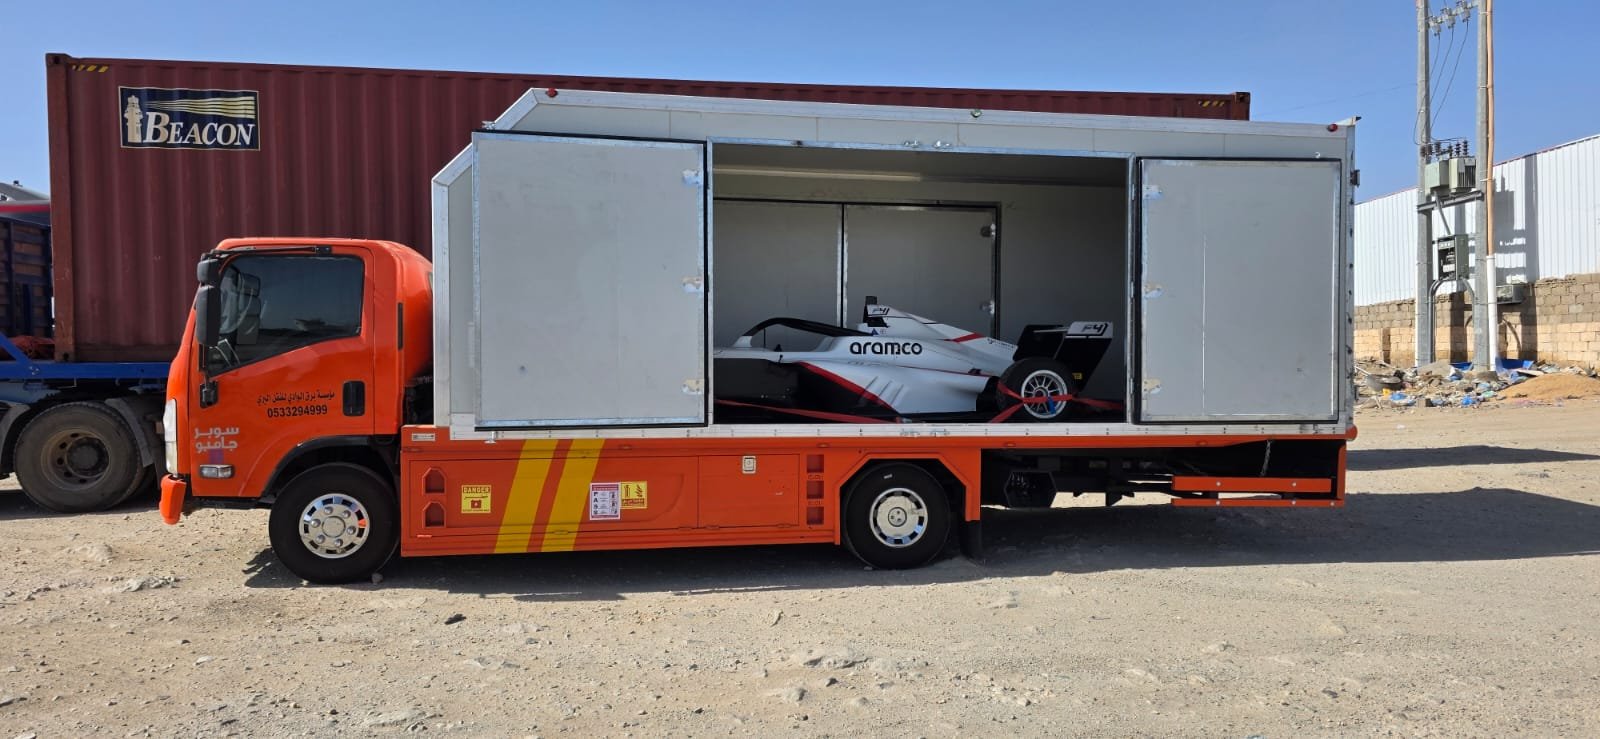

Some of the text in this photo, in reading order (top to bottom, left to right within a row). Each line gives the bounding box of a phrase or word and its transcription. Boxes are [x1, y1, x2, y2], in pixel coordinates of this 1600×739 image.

[849, 341, 923, 355] aramco
[267, 404, 328, 418] 0533294999
[194, 427, 239, 439] سوبر
[195, 436, 238, 453] جامبو
